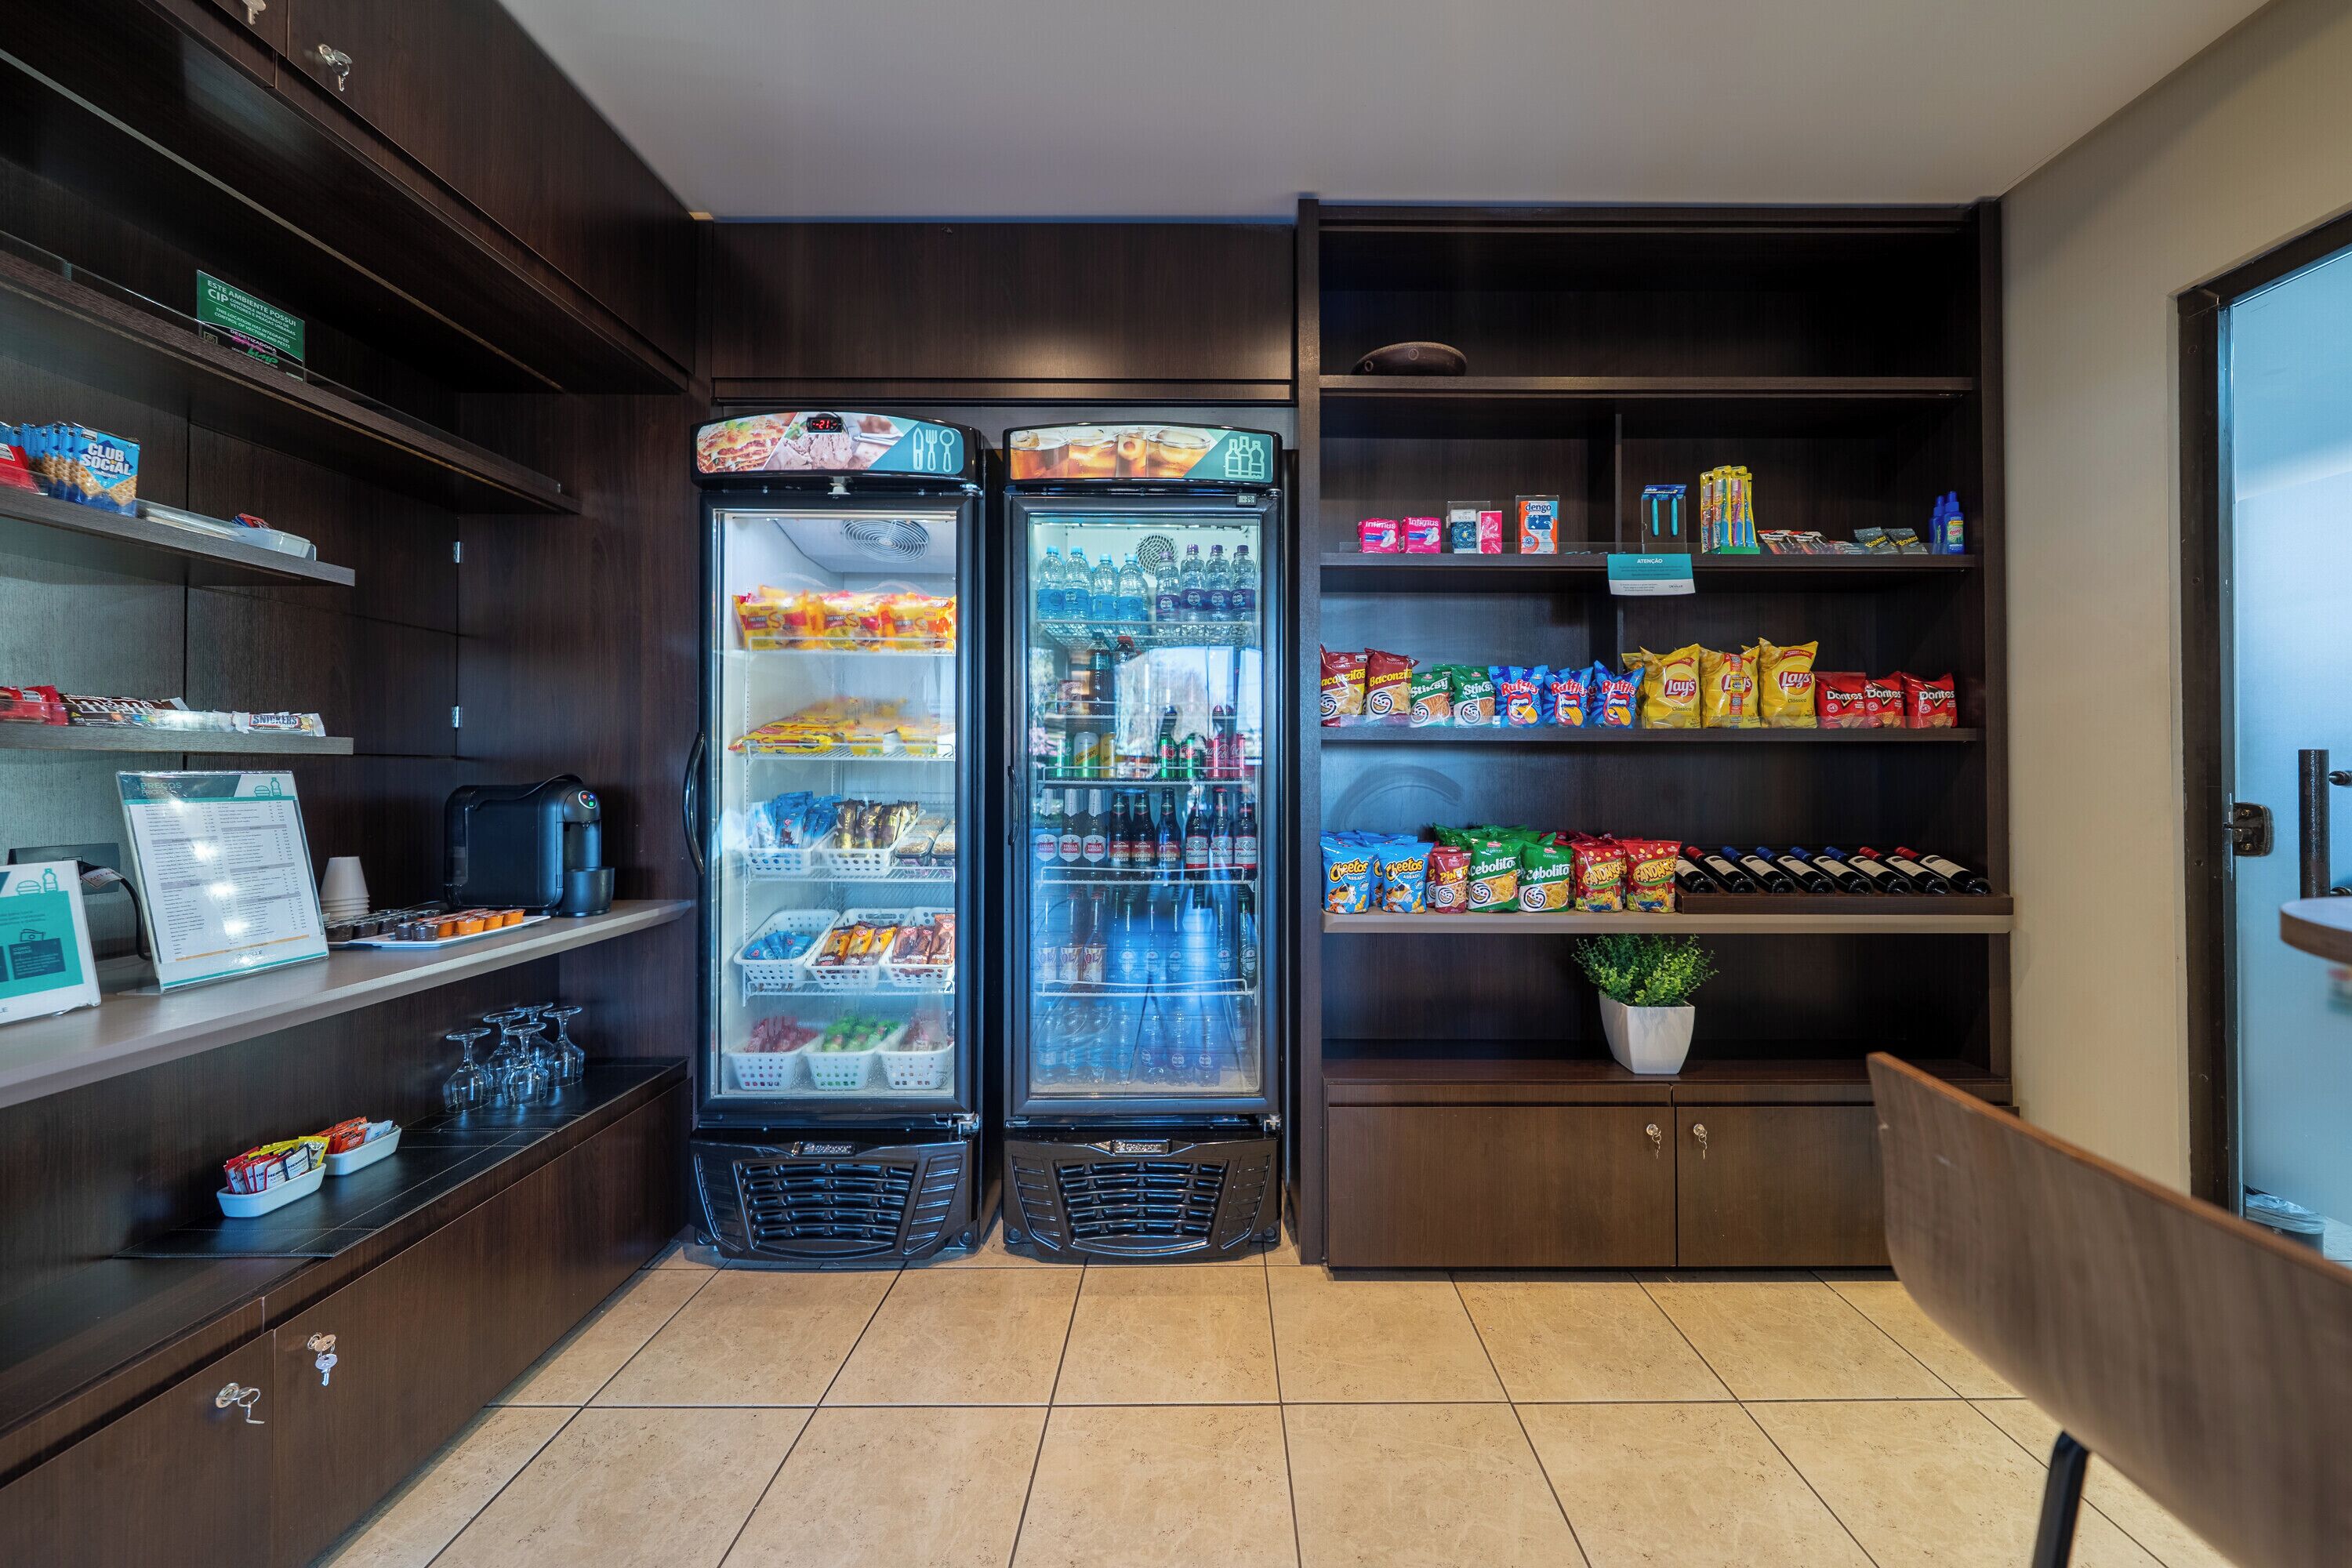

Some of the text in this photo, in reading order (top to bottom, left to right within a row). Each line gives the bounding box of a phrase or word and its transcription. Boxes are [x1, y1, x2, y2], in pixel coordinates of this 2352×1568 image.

[208, 289, 229, 303] CIP
[208, 280, 296, 326] ESTE AMBIENTE POSSUI
[230, 298, 256, 313] CONTROLE
[256, 310, 282, 326] INTEGRADO
[230, 302, 252, 315] VETORES
[256, 314, 274, 326] PRAGAS
[274, 323, 296, 336] URBANAS
[214, 311, 238, 325] CONTROL
[245, 325, 267, 338] VECTORS
[277, 339, 290, 349] PESTS
[227, 312, 252, 326] LOCATION
[262, 328, 289, 343] INTEGRATED
[230, 328, 278, 353] DEDETIZADORA
[88, 442, 125, 462] CLUB
[93, 470, 118, 479] ORIGINAL
[1526, 503, 1552, 513] dengo
[1365, 521, 1396, 529] Intimus
[1408, 517, 1439, 527] Intimus
[1321, 668, 1366, 687] aconzitos
[1370, 669, 1413, 687] Baconzito
[1781, 671, 1811, 689] Lay's
[1501, 679, 1539, 695] Ruffles
[1551, 679, 1588, 697] Ruffles
[1666, 679, 1696, 696] Lay's
[1826, 690, 1864, 700] Doritos
[1866, 688, 1901, 699] Doritos
[1919, 691, 1955, 700] Doritos
[252, 714, 297, 725] SNICKERS
[141, 782, 183, 790] PREÇOS
[1329, 858, 1369, 883] Cheetos
[1385, 858, 1424, 882] Cheetos
[1526, 863, 1570, 880] Cebolito
[287, 1154, 308, 1169] HEMMER
